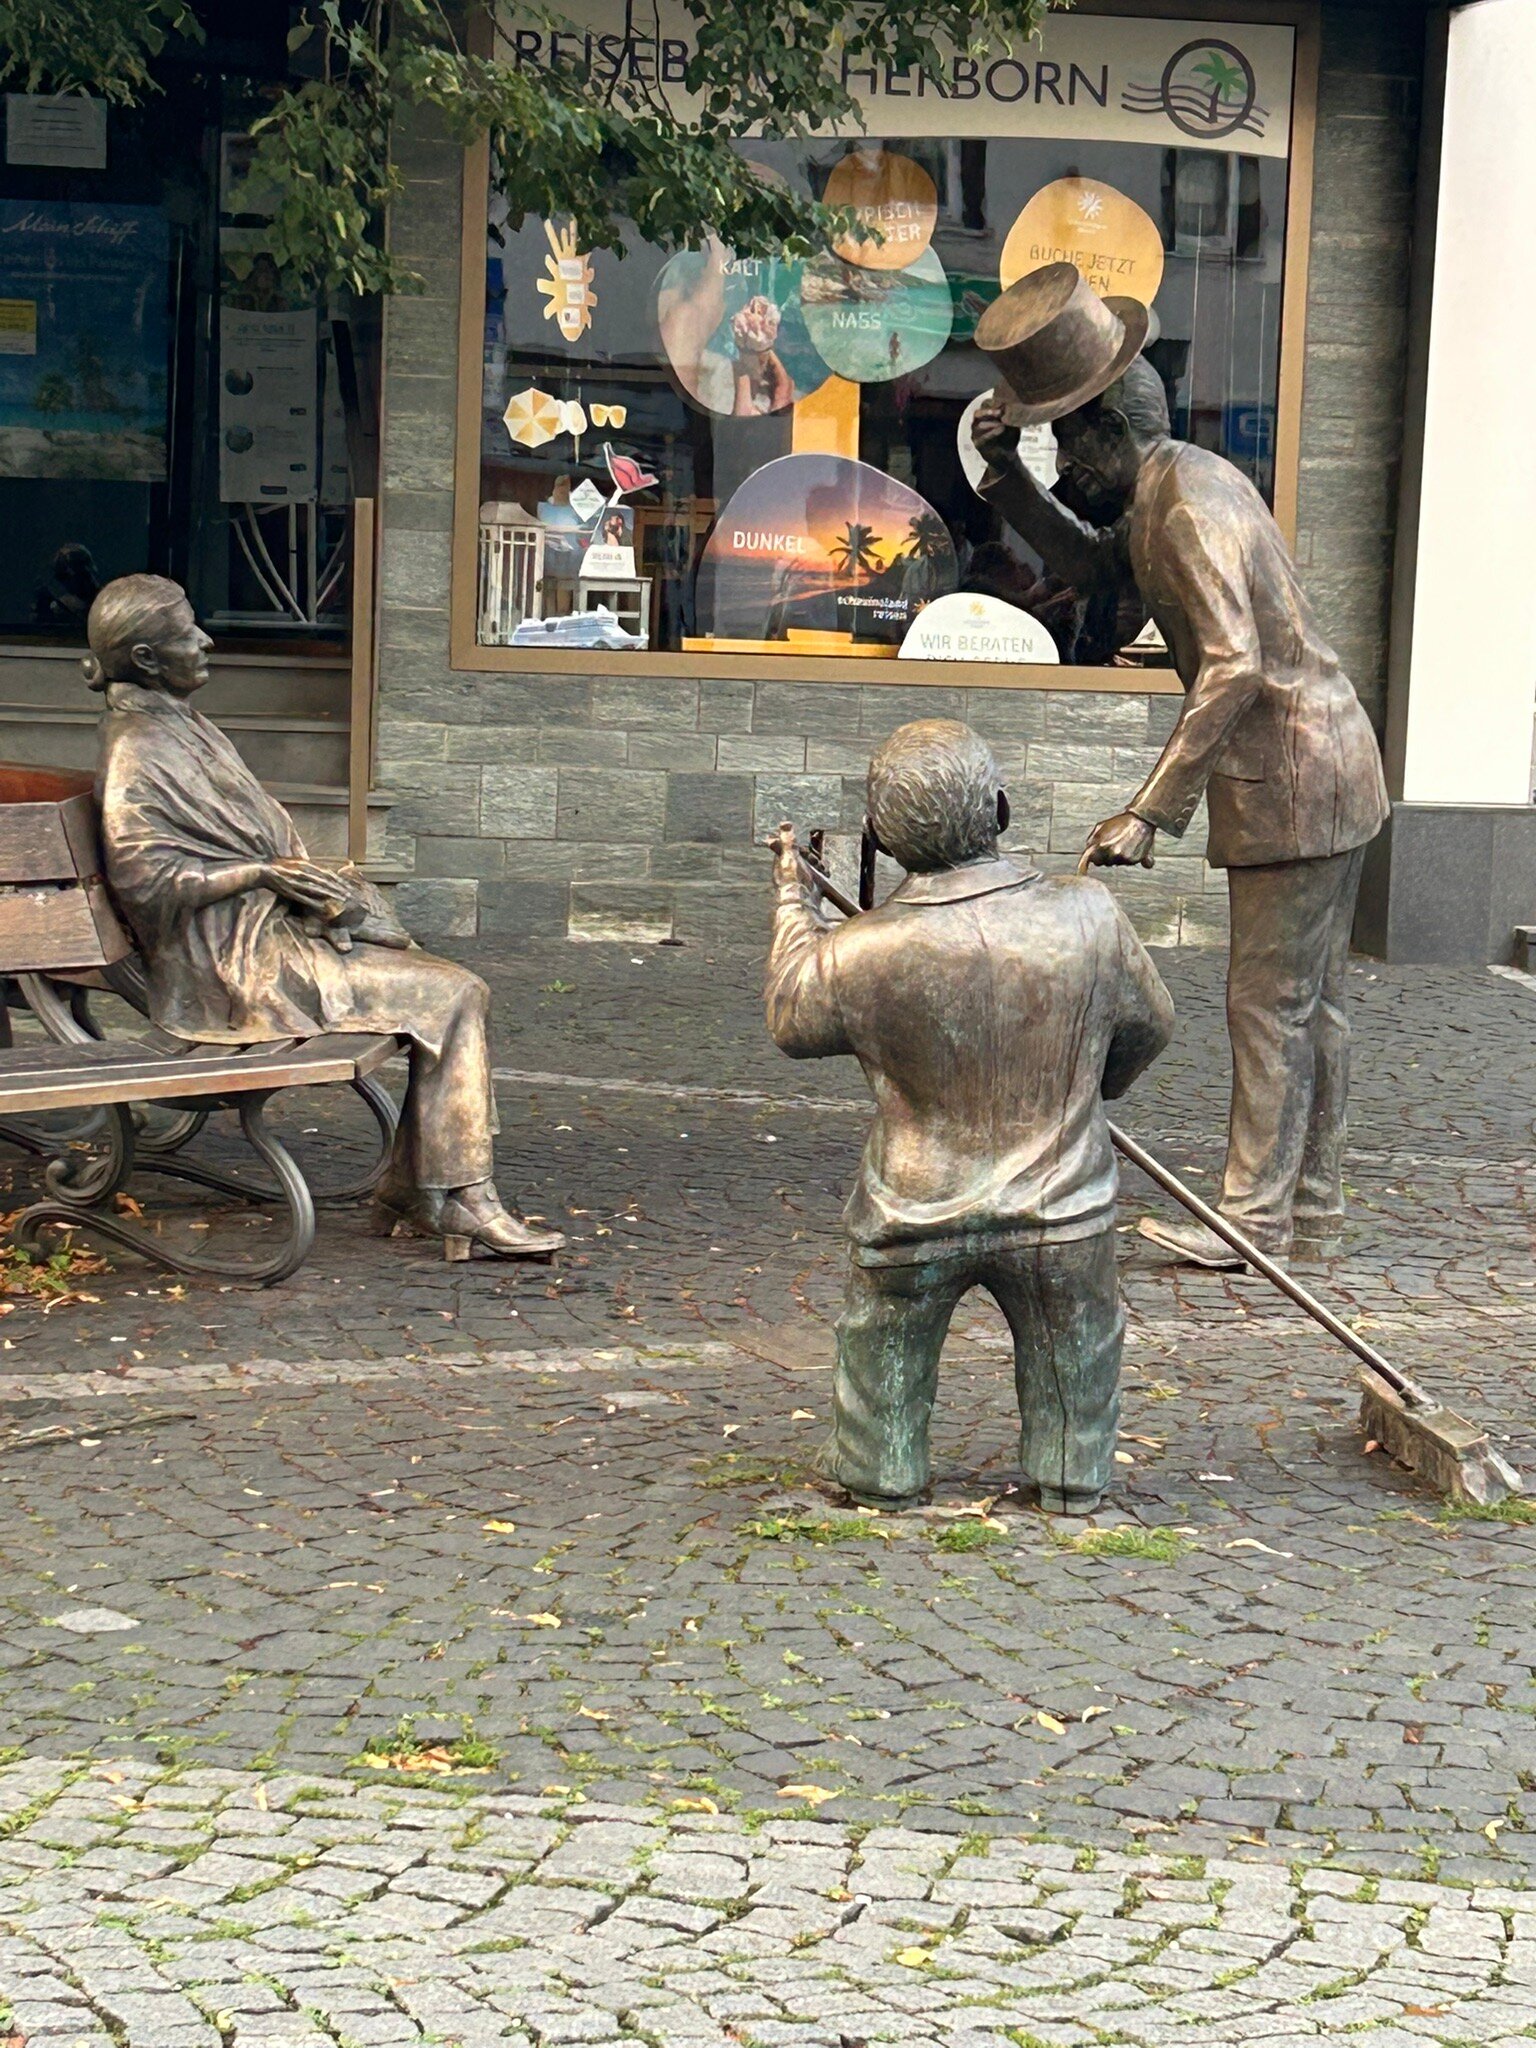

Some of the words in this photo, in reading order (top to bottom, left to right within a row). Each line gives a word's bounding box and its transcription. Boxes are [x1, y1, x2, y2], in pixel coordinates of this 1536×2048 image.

[719, 258, 762, 276] KALT
[1030, 245, 1084, 268] BUCHE
[1087, 254, 1136, 275] JETZT
[832, 311, 882, 330] NASS
[732, 530, 807, 554] DUNKEL
[920, 633, 951, 650] WIR
[957, 635, 1034, 653] BERATEN
